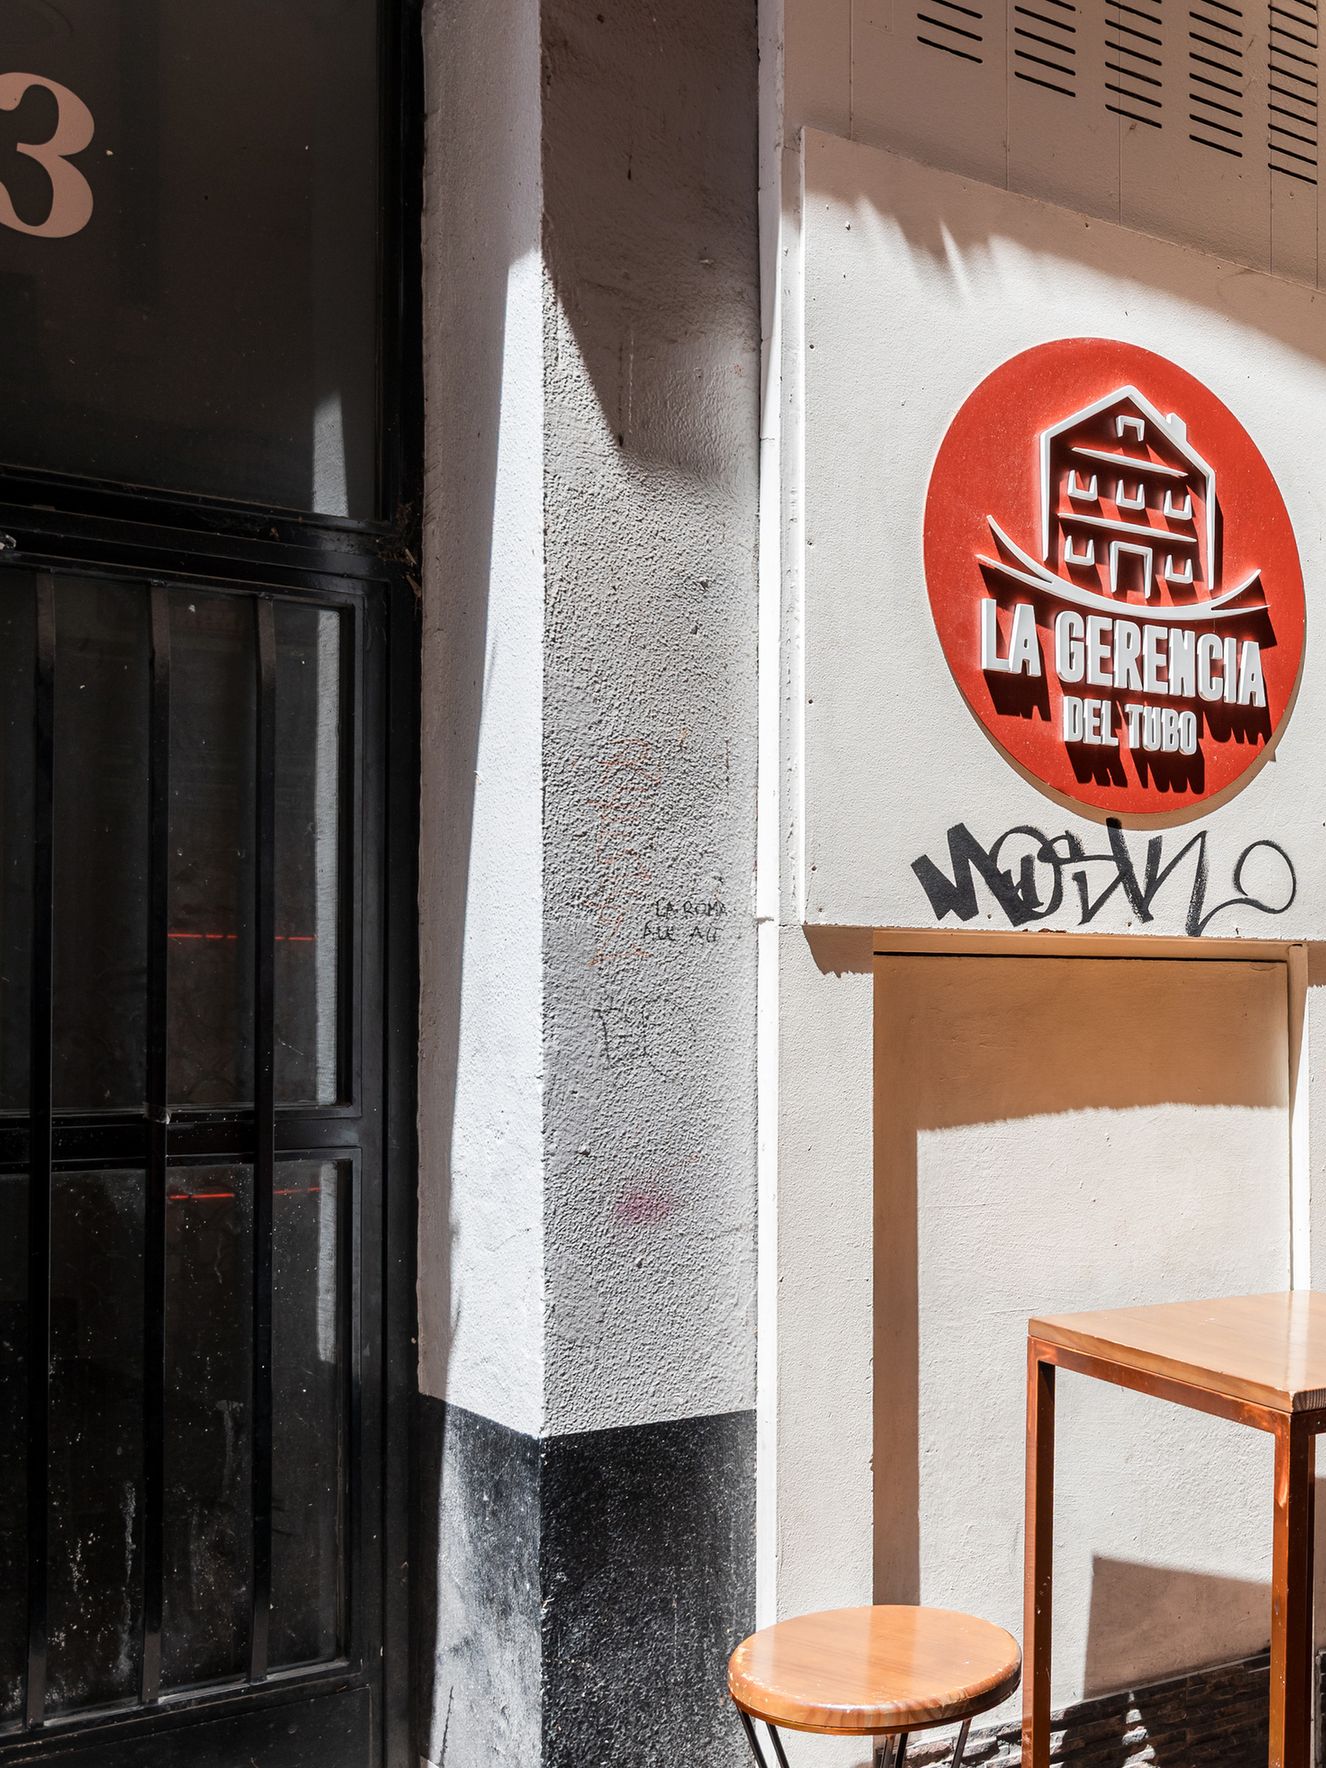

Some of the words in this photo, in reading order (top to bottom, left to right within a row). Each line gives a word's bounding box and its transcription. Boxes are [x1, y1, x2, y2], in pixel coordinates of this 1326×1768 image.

[0, 71, 96, 239] 3
[980, 597, 1042, 678] LA
[1054, 610, 1267, 708] GERENCIA
[1062, 694, 1120, 749] DEL
[1123, 702, 1198, 757] TUBO
